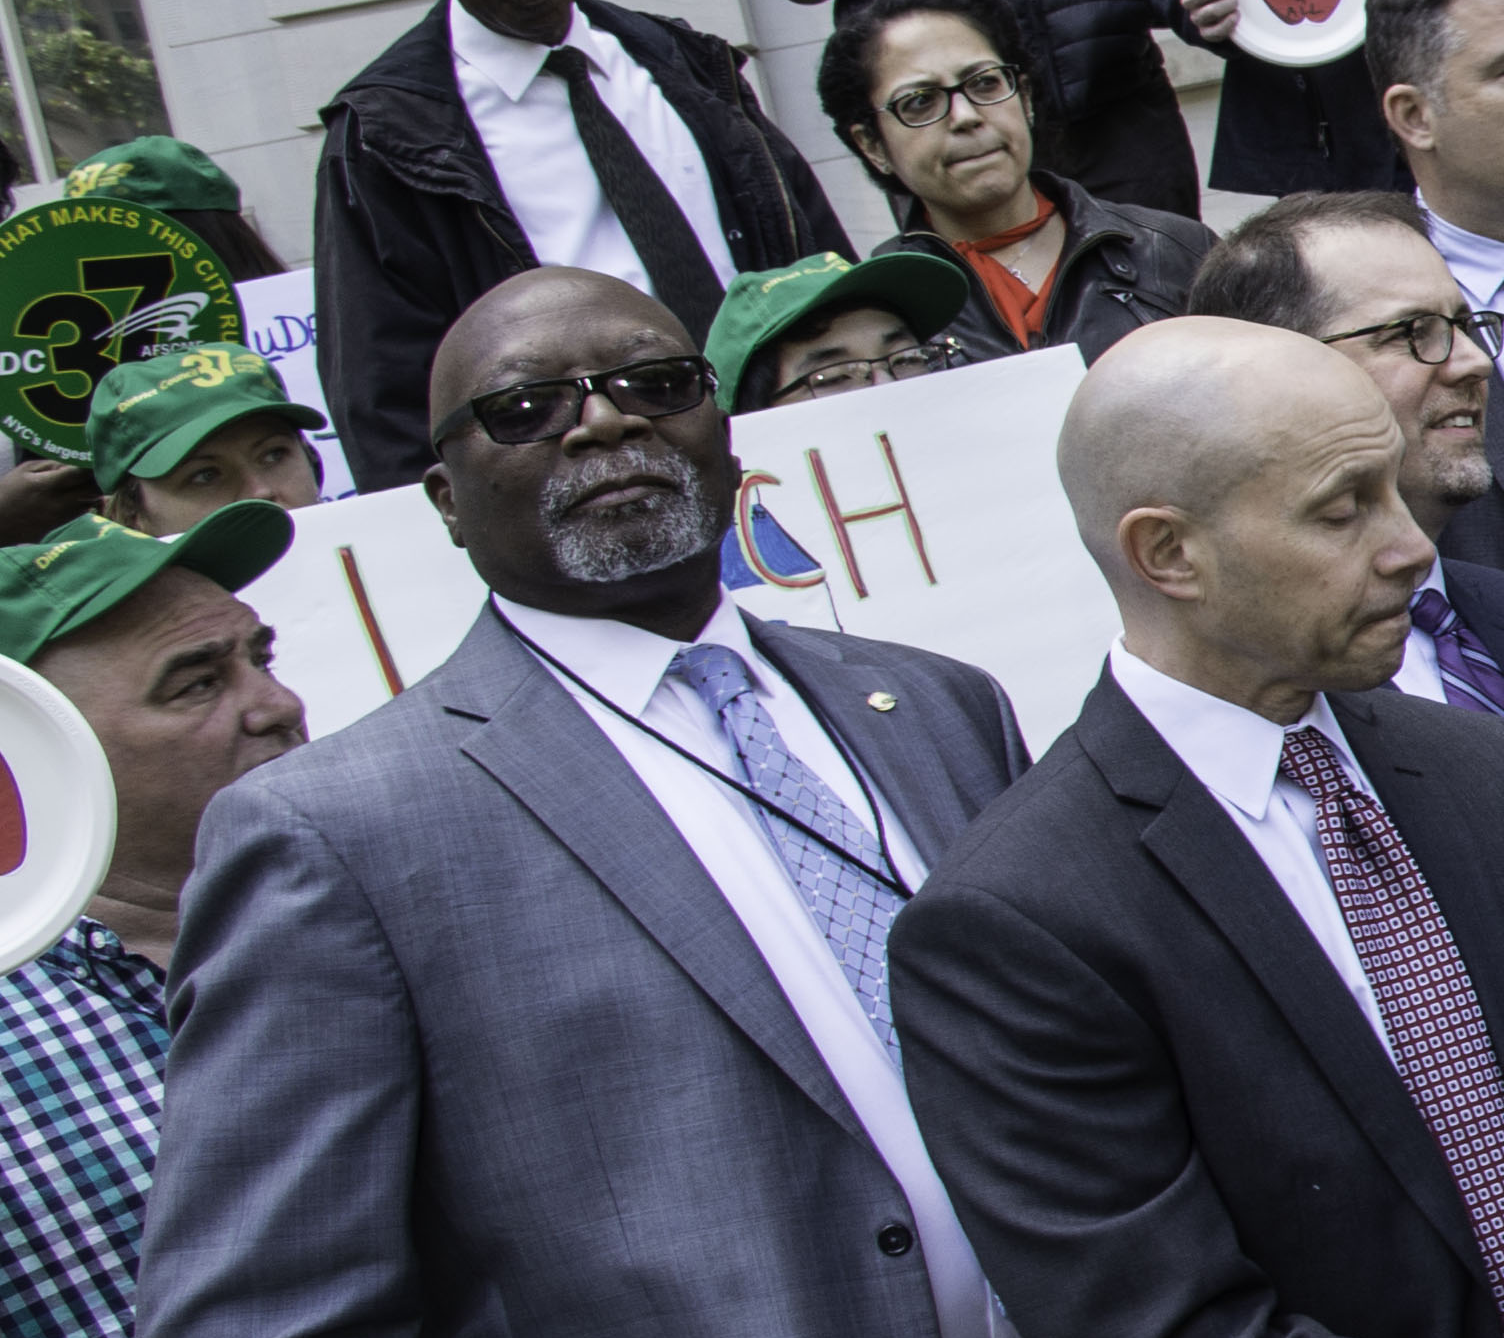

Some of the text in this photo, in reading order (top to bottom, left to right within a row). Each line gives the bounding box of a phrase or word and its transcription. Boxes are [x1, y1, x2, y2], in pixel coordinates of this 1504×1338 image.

[50, 204, 141, 230] MAKES
[147, 217, 200, 262] THIS
[193, 258, 236, 307] CITY
[218, 313, 239, 344] RU
[0, 251, 177, 428] DC 37
[180, 348, 236, 388] 37
[2, 414, 93, 463] NYC's largest
